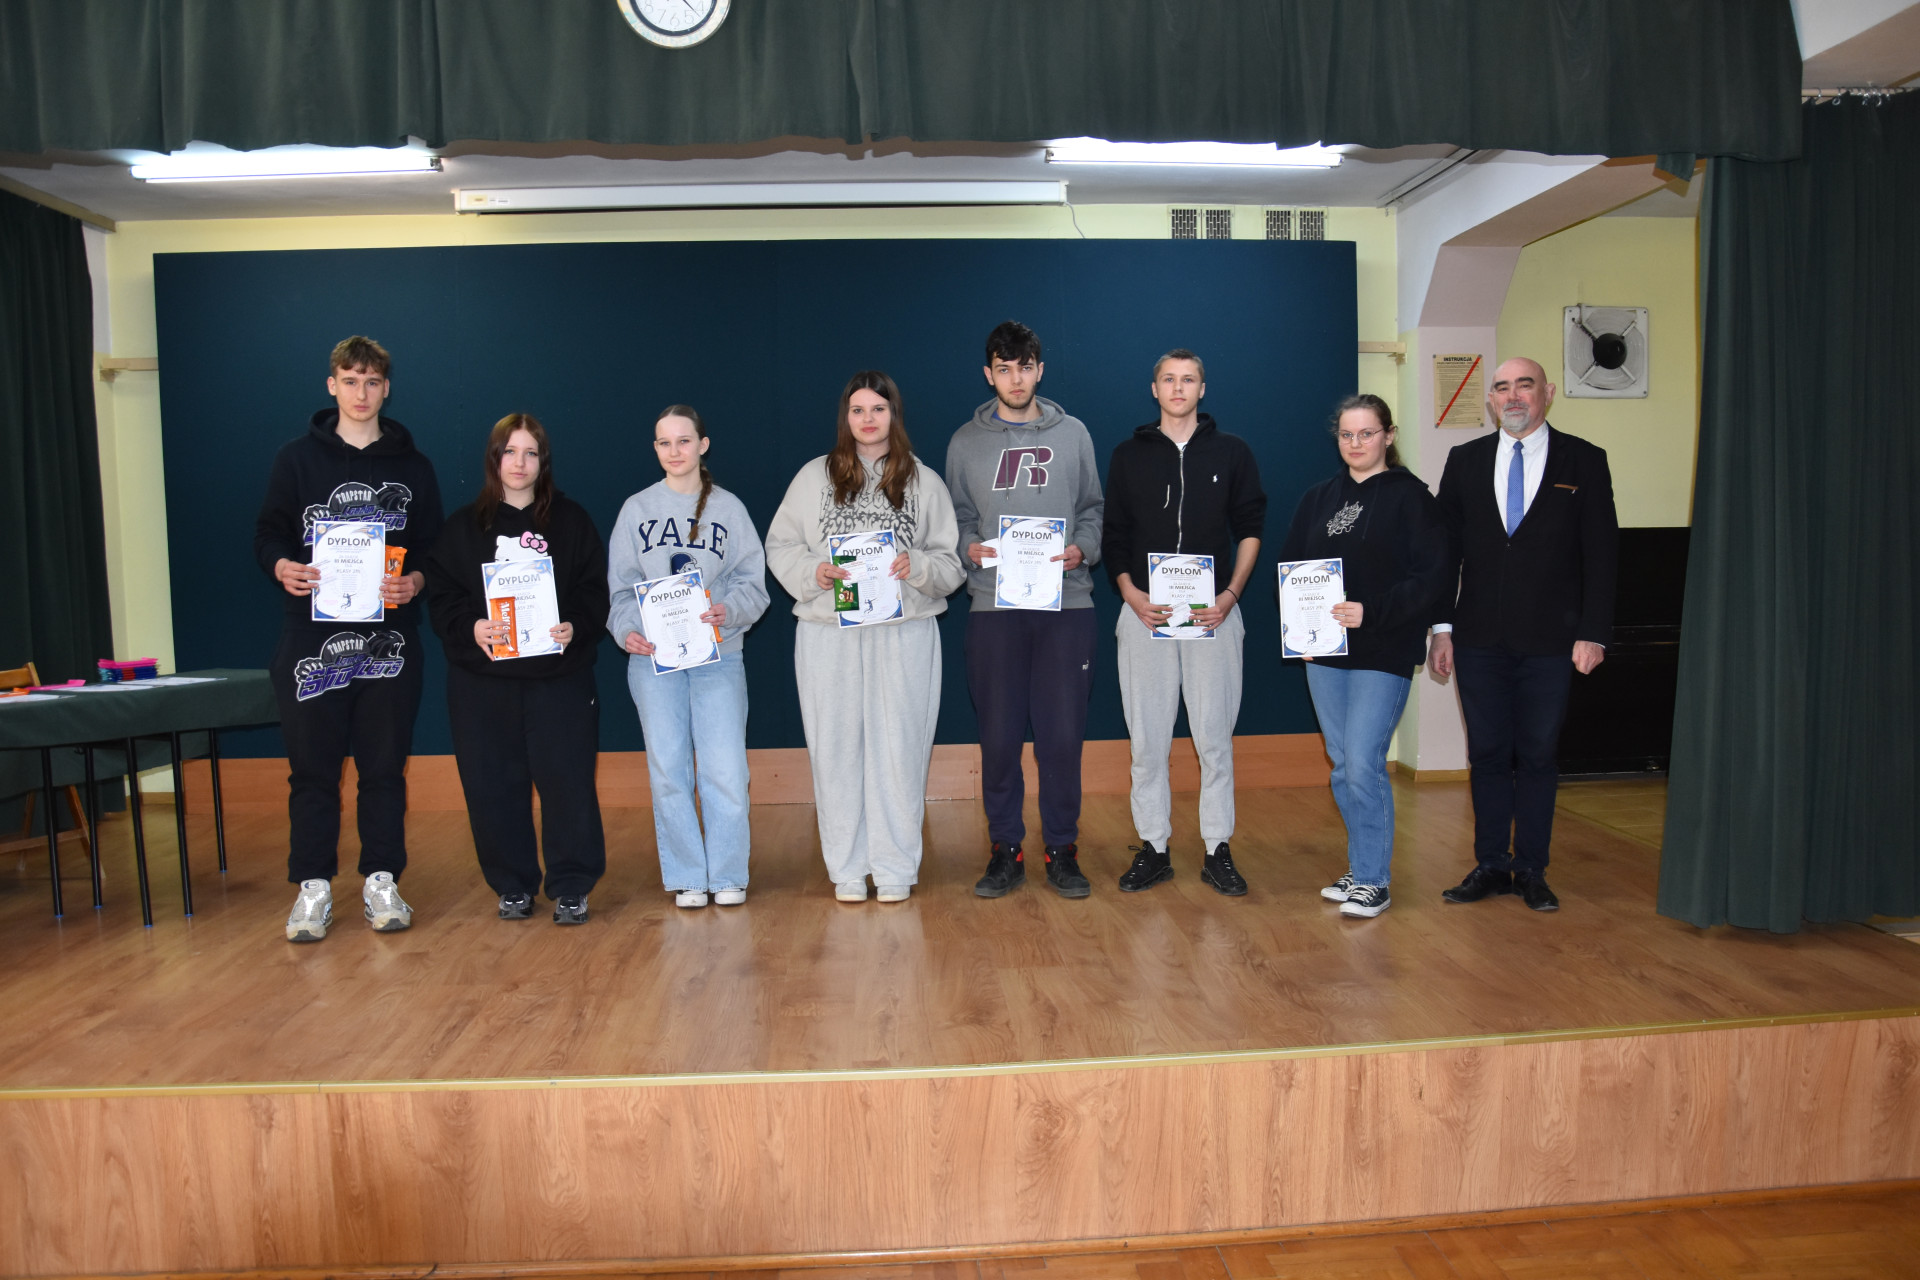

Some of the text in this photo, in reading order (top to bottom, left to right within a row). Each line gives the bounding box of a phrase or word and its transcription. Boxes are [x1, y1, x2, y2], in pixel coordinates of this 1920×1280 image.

[335, 489, 373, 505] TRAPSTAR
[638, 517, 728, 560] YALE
[1011, 530, 1053, 541] DYPLOM
[327, 537, 372, 548] DYPLOM
[842, 546, 884, 557] DYPLOM
[1161, 567, 1202, 576] DYPLOM
[498, 573, 542, 586] DYPLOM
[1291, 574, 1331, 585] DYPLOM
[650, 587, 692, 604] DYPLOM
[326, 638, 364, 655] TRAPSTAR
